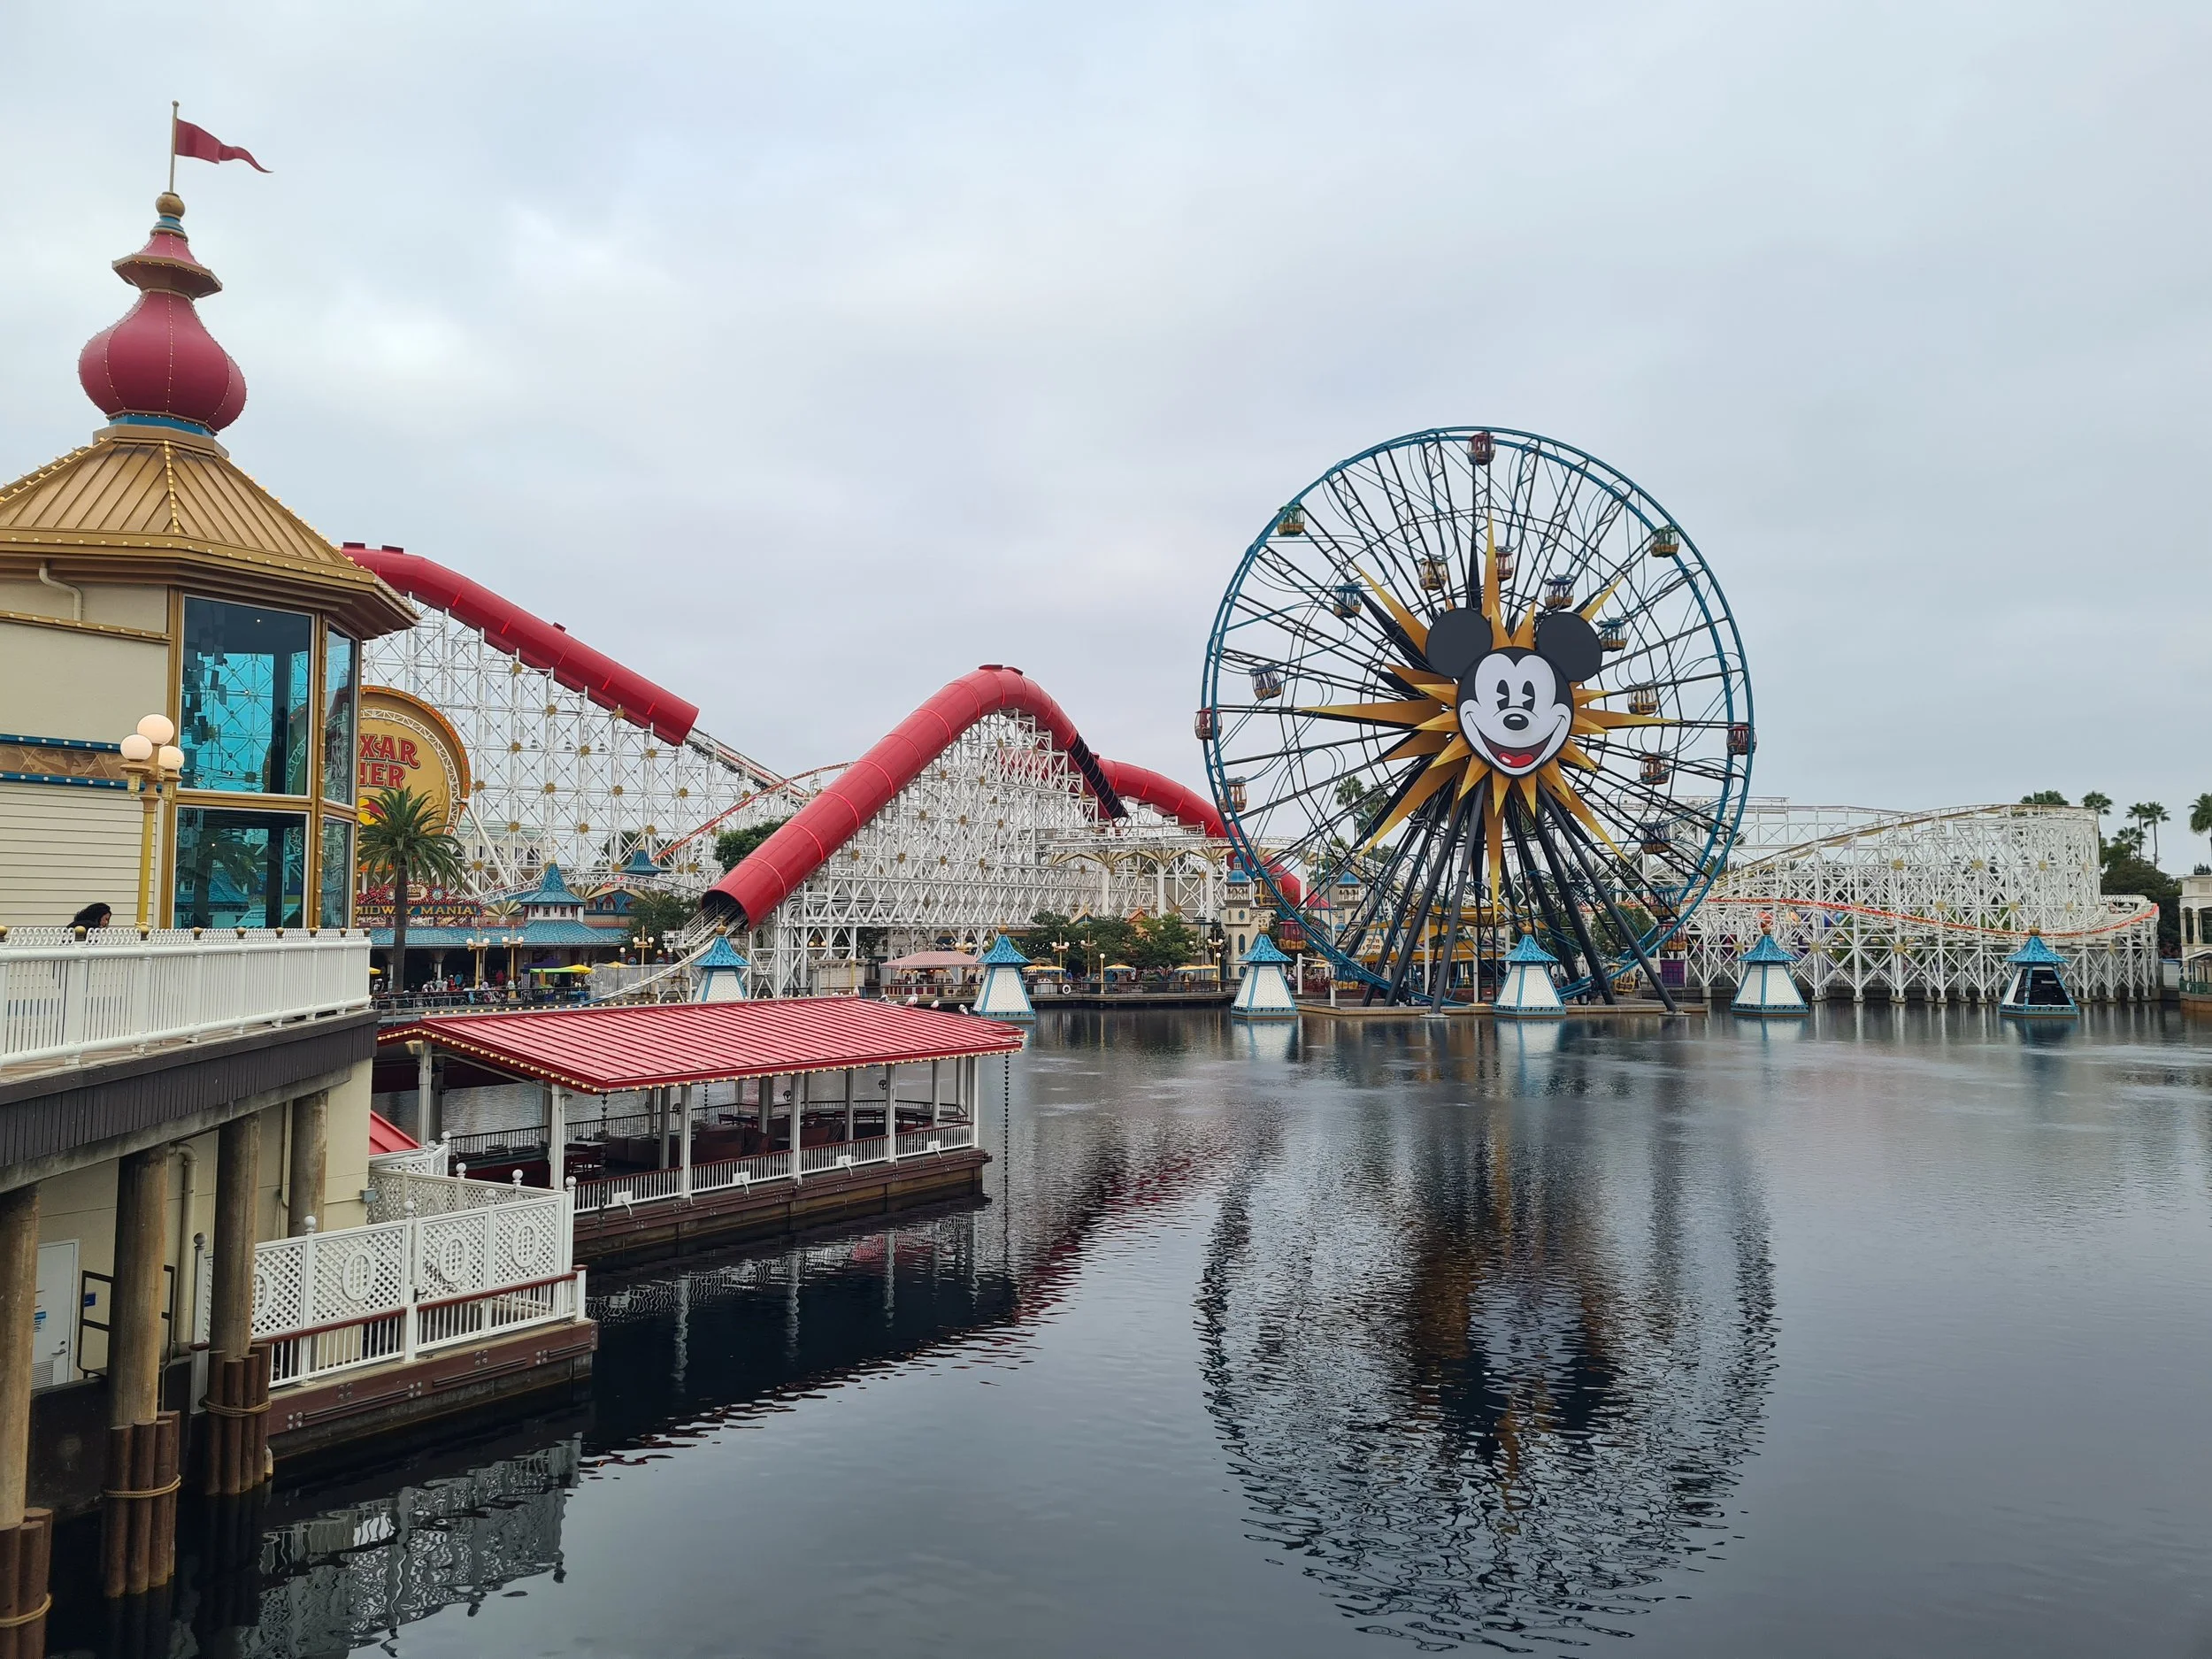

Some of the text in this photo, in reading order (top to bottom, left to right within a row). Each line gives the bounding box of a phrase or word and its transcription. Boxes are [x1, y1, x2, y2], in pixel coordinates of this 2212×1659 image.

[359, 733, 420, 769] XAR
[359, 762, 405, 790] IER
[355, 905, 477, 915] MIDWY MANIA!
